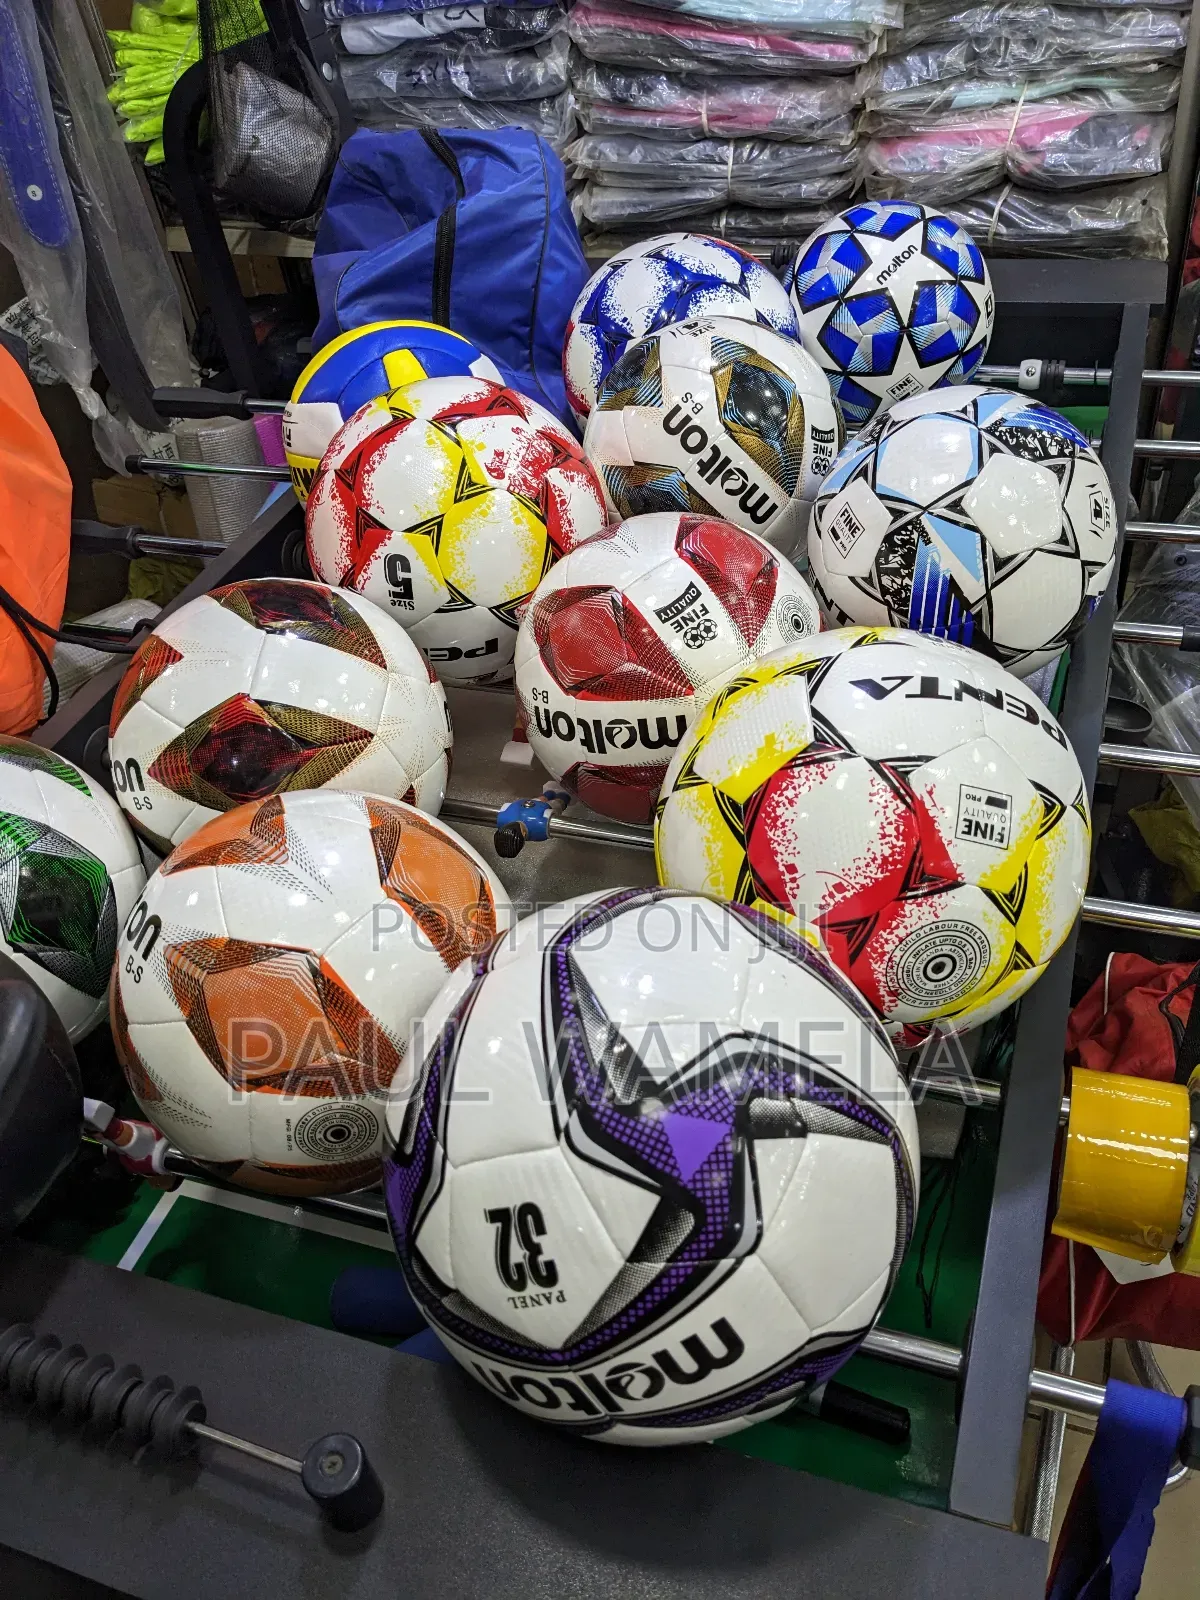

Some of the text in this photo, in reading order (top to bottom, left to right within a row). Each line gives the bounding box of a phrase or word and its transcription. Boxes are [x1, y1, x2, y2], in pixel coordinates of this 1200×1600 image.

[876, 244, 919, 286] molton
[890, 376, 914, 395] FINE
[681, 391, 704, 415] B-S
[811, 427, 835, 442] QUALITY
[662, 403, 779, 525] molton
[813, 442, 833, 458] FINE
[840, 507, 861, 538] FINE
[1093, 498, 1103, 520] 4
[384, 552, 415, 601] 5
[390, 599, 416, 611] Size
[660, 587, 698, 621] QUALITY
[669, 602, 710, 634] FINE
[421, 637, 499, 662] PE
[532, 687, 549, 705] B-S
[848, 675, 1069, 751] PENTA
[534, 705, 689, 755] molton
[111, 757, 146, 793] on
[132, 796, 153, 811] B-S
[965, 793, 982, 803] PRO
[963, 806, 1007, 824] QUALITY
[960, 817, 1006, 844] FINE
[899, 922, 989, 969] CHILD LABOUR FREE PRODUCT
[125, 954, 144, 984] B-S
[483, 1201, 559, 1293] 32
[507, 1289, 568, 1309] PANEL
[470, 1316, 745, 1417] molton
